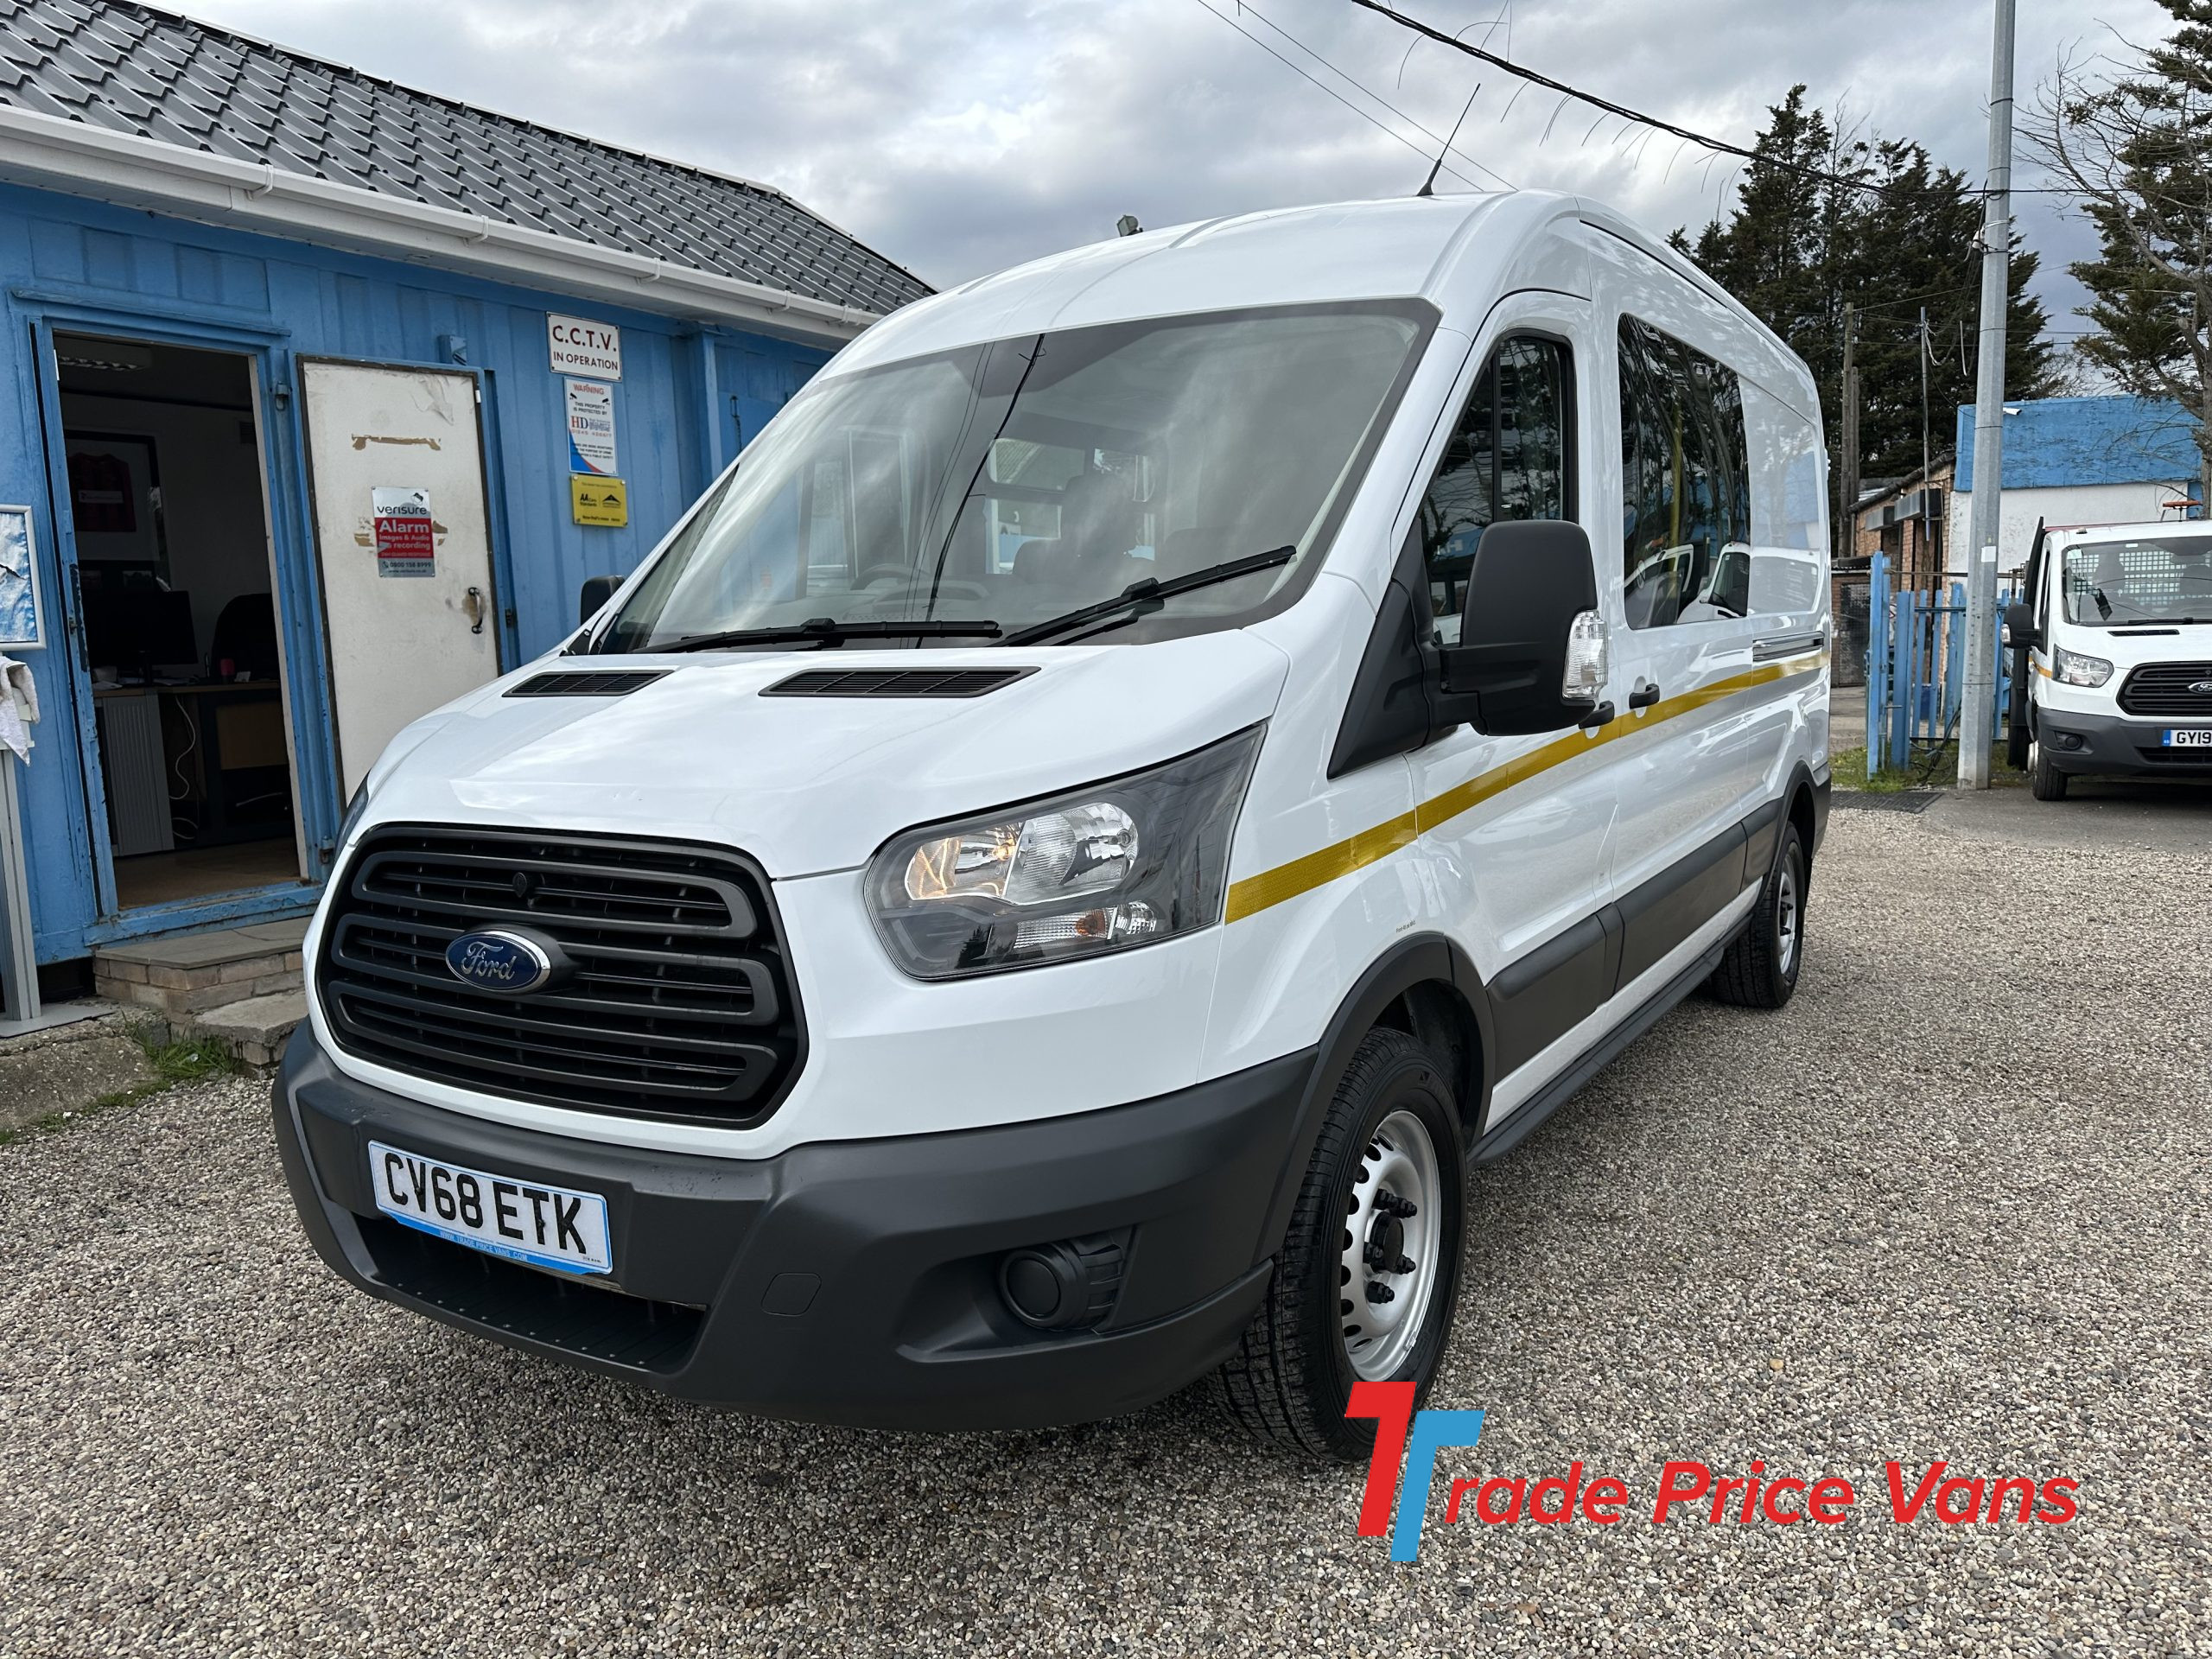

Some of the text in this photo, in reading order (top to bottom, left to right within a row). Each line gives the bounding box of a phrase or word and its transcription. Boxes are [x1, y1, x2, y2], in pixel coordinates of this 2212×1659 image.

[552, 325, 617, 352] C.C.T.V.
[553, 351, 618, 371] IN OPERATION
[573, 384, 605, 395] WARNING
[571, 416, 588, 429] HD
[377, 505, 428, 515] verisure
[379, 519, 429, 533] Alarm
[379, 534, 403, 543] Images
[393, 541, 430, 551] recording
[2177, 731, 2212, 744] GY19
[461, 941, 518, 981] Ford
[385, 1152, 588, 1255] CV68 ETK
[457, 1236, 475, 1247] TRADE
[475, 1241, 493, 1253] PRICE
